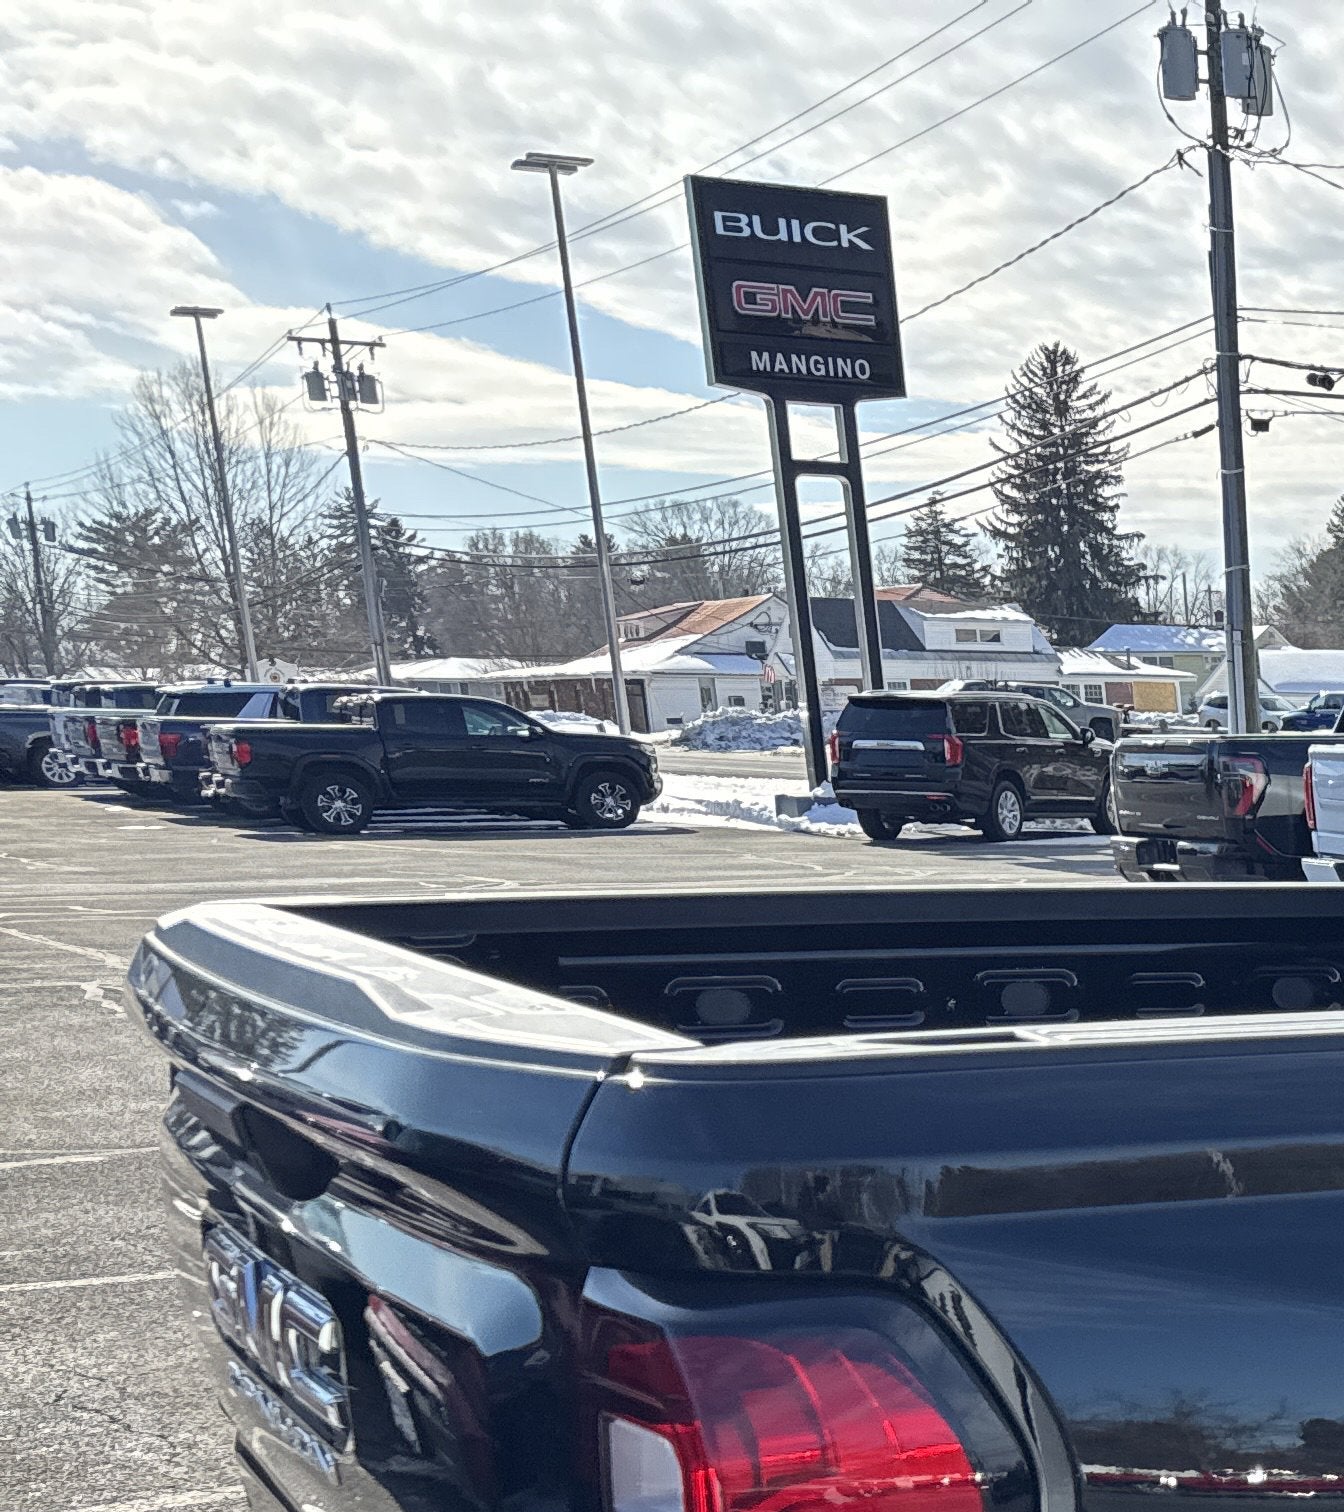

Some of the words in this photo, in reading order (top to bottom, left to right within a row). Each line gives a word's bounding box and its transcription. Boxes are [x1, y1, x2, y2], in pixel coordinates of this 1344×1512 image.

[713, 210, 875, 251] BUICK
[731, 280, 877, 326] GMC
[750, 350, 871, 380] MANGINO
